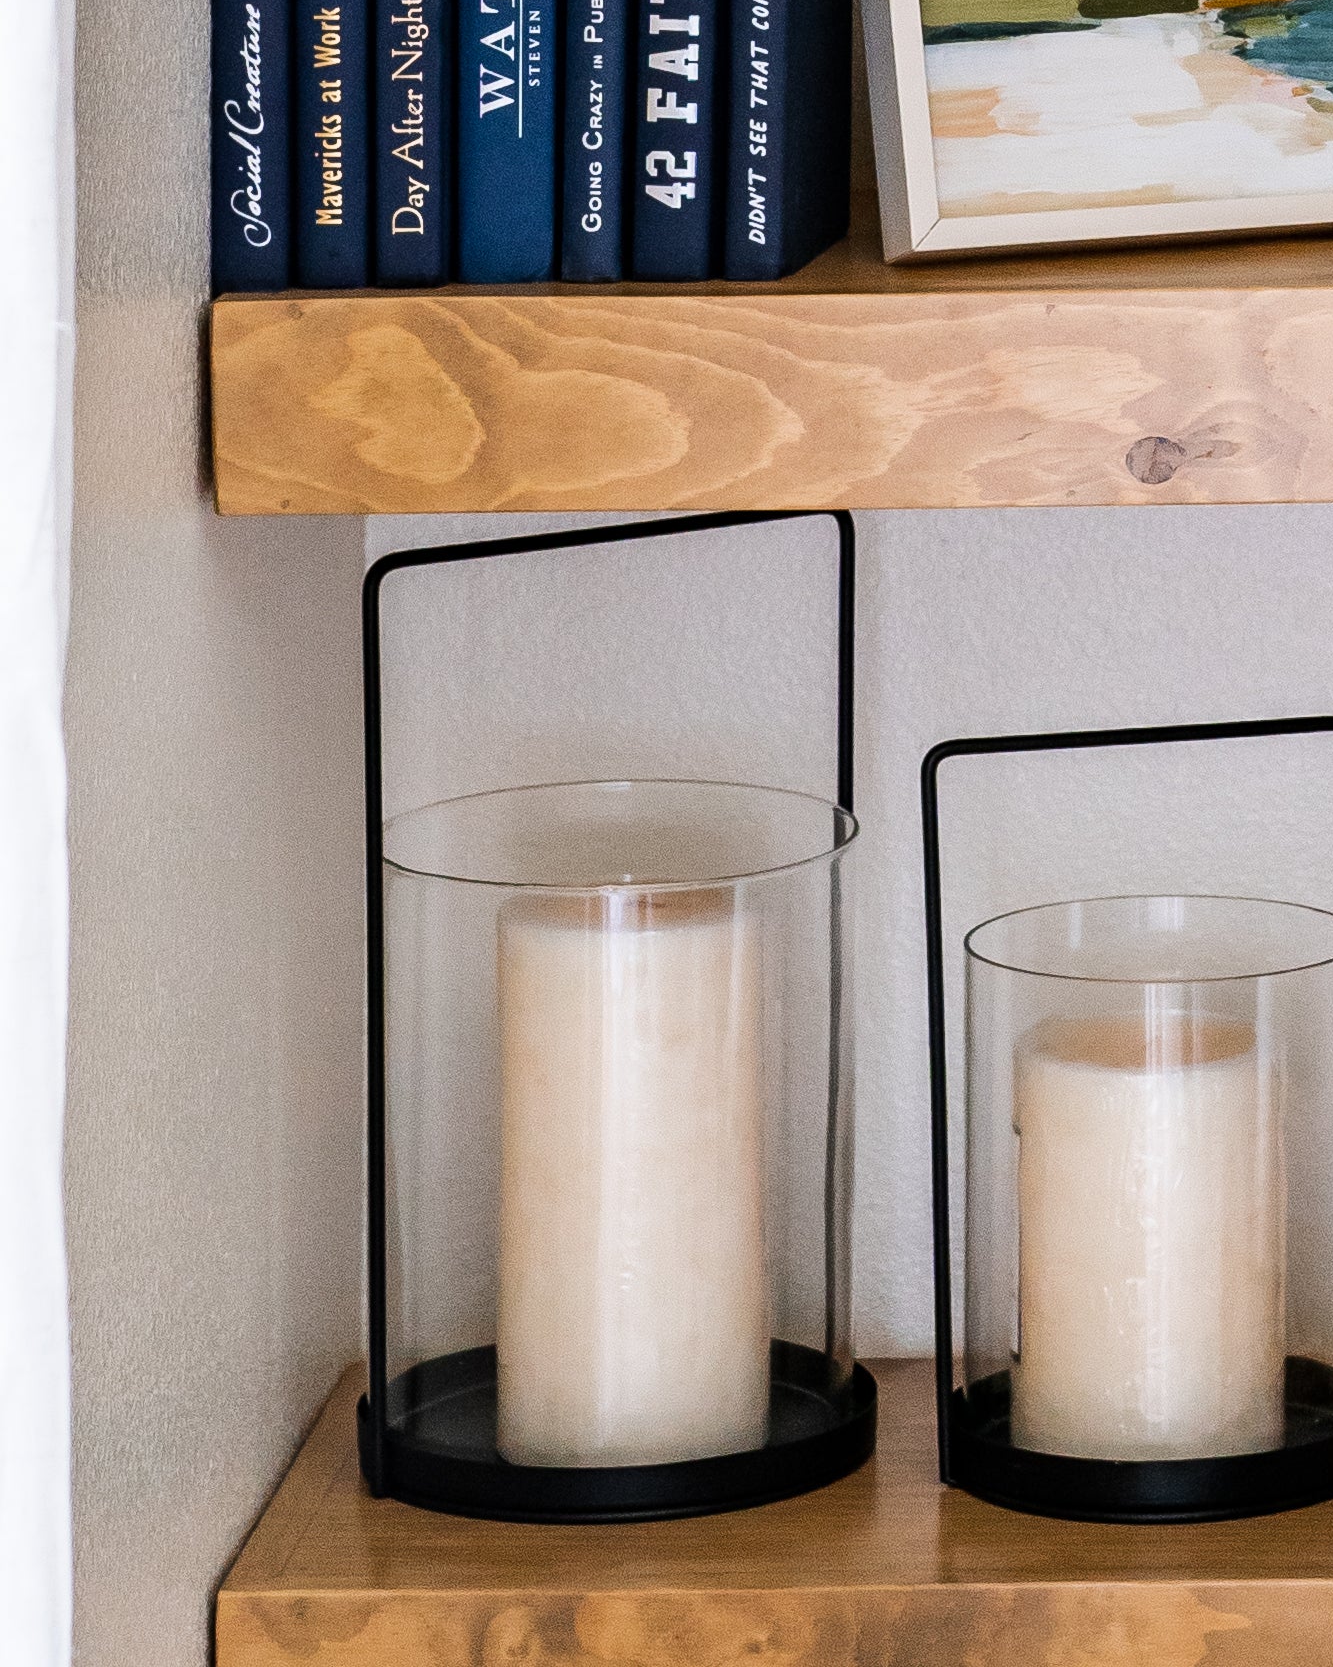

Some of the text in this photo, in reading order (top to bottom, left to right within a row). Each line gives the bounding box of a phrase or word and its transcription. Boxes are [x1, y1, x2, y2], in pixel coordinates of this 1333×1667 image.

[528, 10, 541, 87] STEVEN
[749, 40, 770, 109] THAT
[223, 3, 272, 248] Social Creature
[313, 6, 343, 225] Mavericks at Work
[391, 88, 424, 170] After
[748, 118, 768, 157] SEE
[391, 176, 430, 235] Day
[645, 150, 697, 210] 42
[747, 167, 767, 245] DIDN'T
